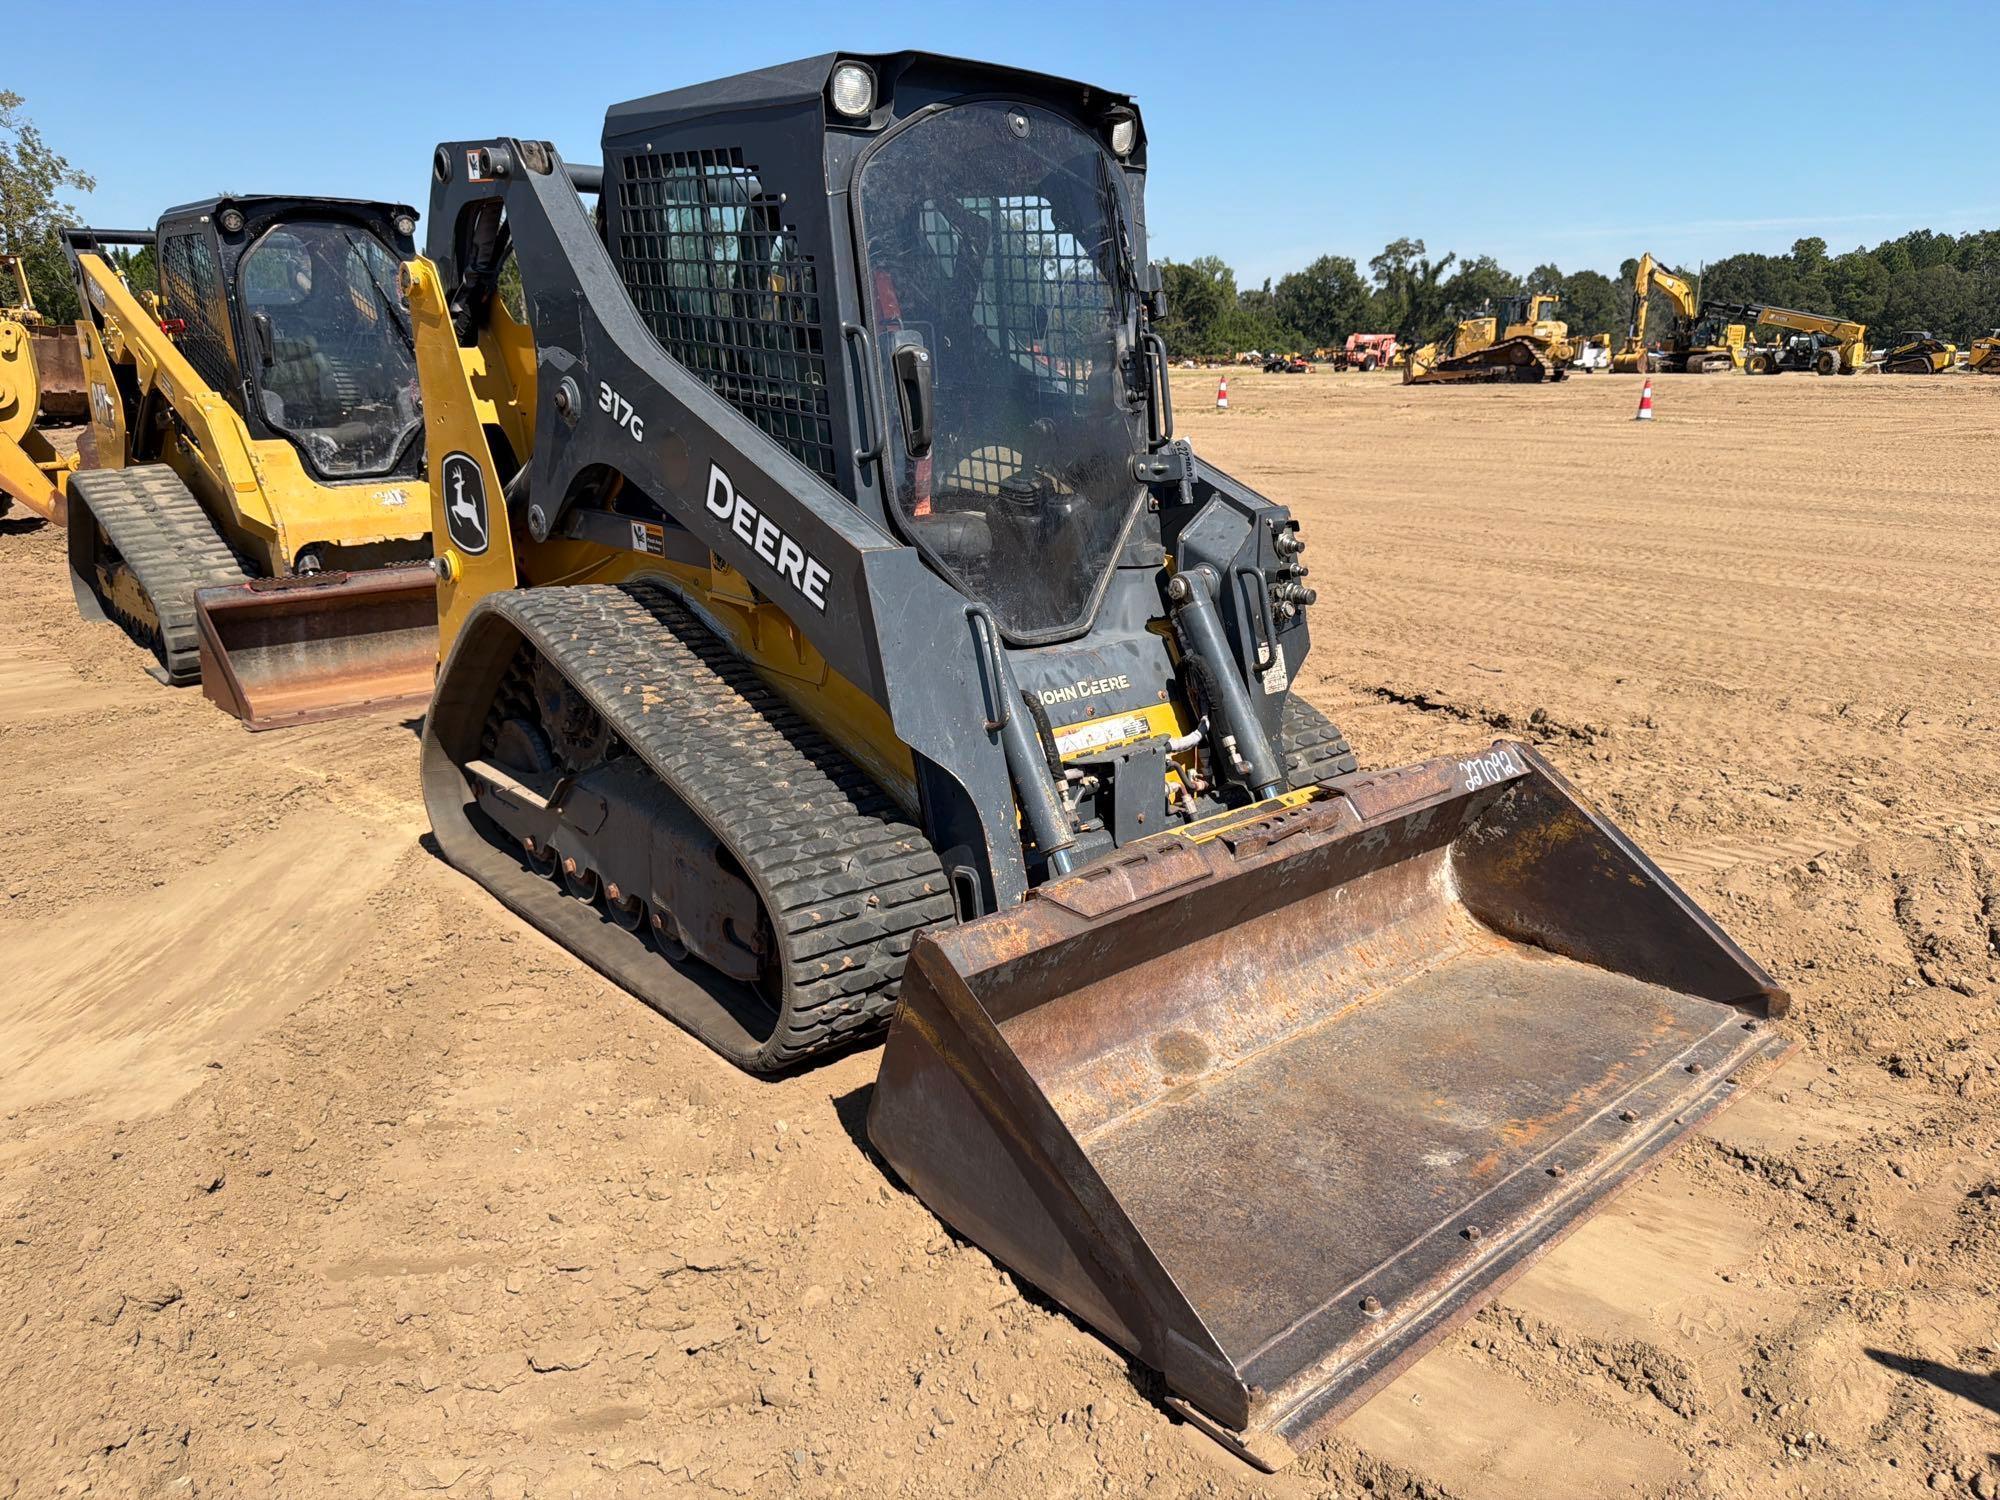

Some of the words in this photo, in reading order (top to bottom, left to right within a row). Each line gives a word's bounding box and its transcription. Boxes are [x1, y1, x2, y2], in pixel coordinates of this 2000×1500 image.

[598, 380, 644, 443] 317G
[705, 463, 831, 611] DEERE
[1037, 686, 1078, 706] JOHN
[1077, 675, 1131, 698] DEERE
[1458, 750, 1520, 791] 227092
